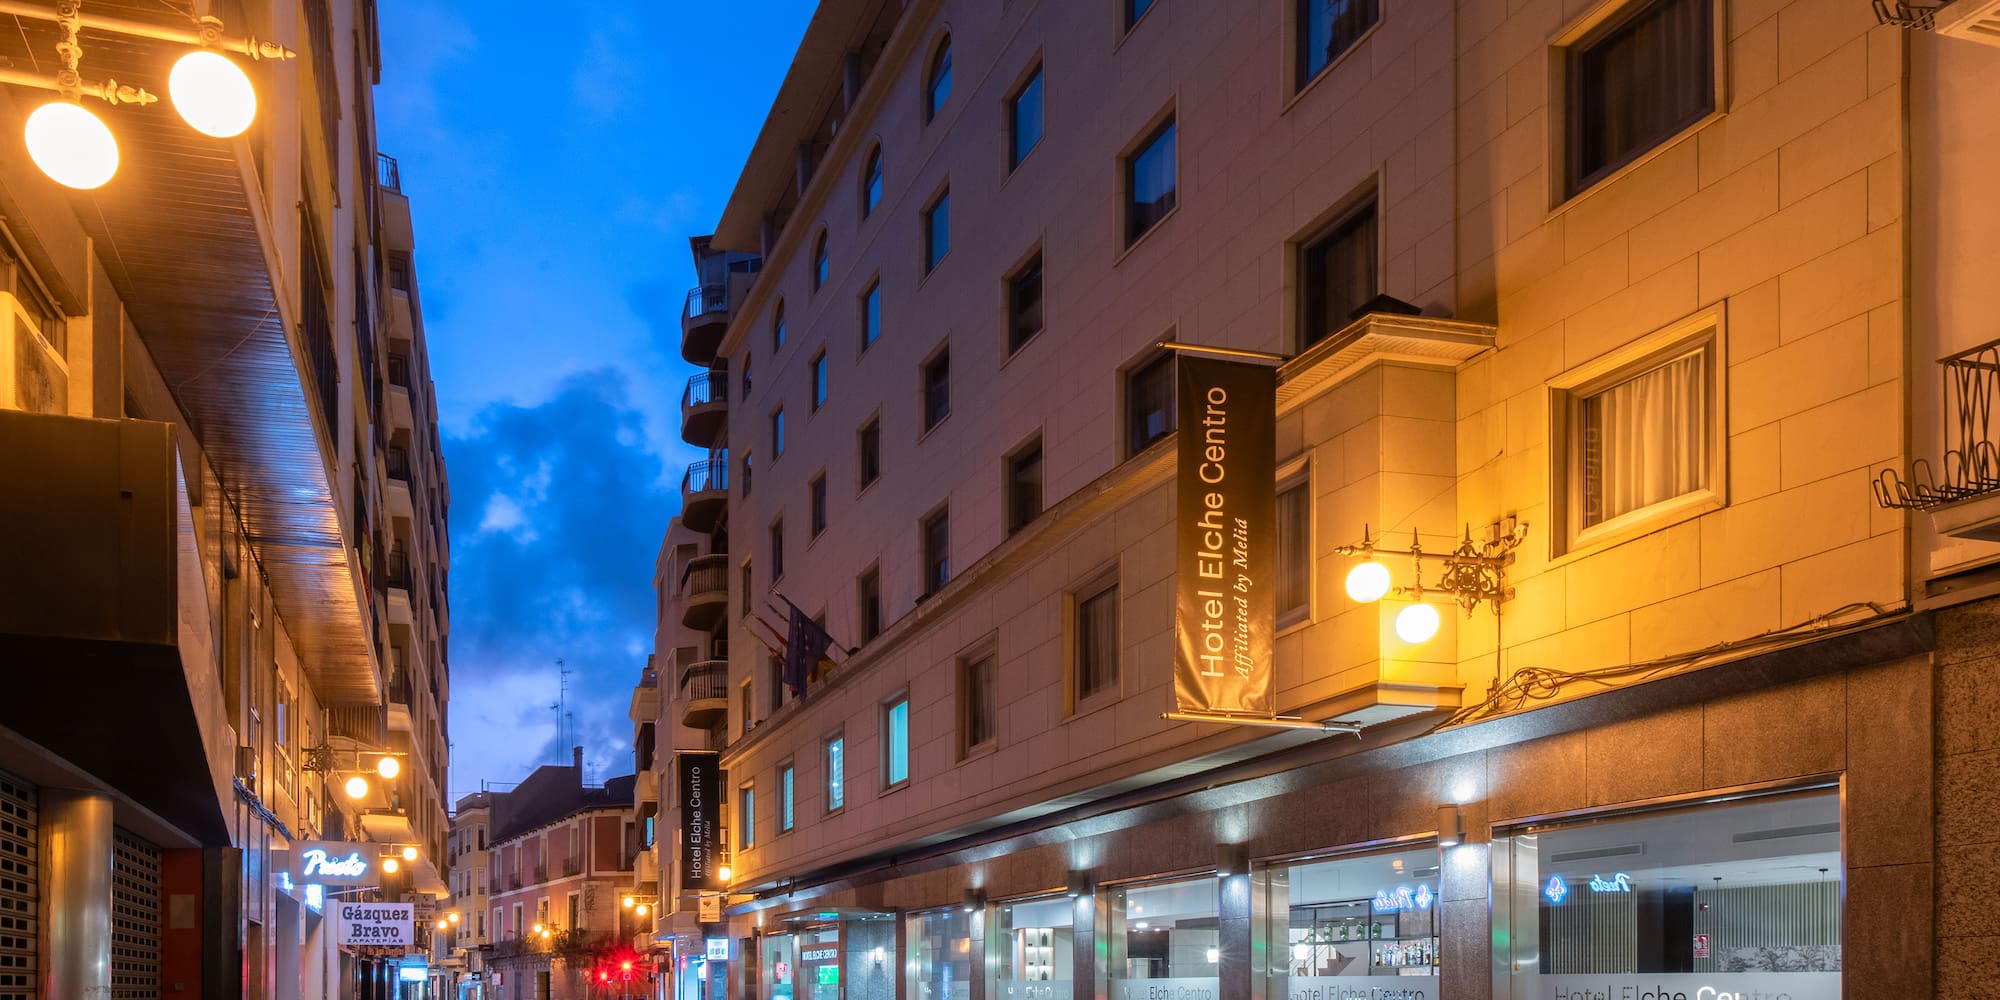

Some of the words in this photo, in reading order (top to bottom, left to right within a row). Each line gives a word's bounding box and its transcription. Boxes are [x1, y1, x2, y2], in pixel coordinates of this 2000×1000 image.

[1199, 386, 1227, 484] Centro
[1197, 492, 1224, 579] Elche
[1233, 518, 1249, 570] Meliá
[1234, 574, 1253, 593] by
[1198, 590, 1224, 677] Hotel
[1233, 599, 1254, 681] Affiliated
[690, 766, 701, 808] Centro
[690, 811, 702, 844] Elche
[303, 849, 368, 876] Prieto
[691, 847, 702, 879] Hotel
[342, 905, 409, 924] Gázquez
[351, 923, 400, 937] Bravo
